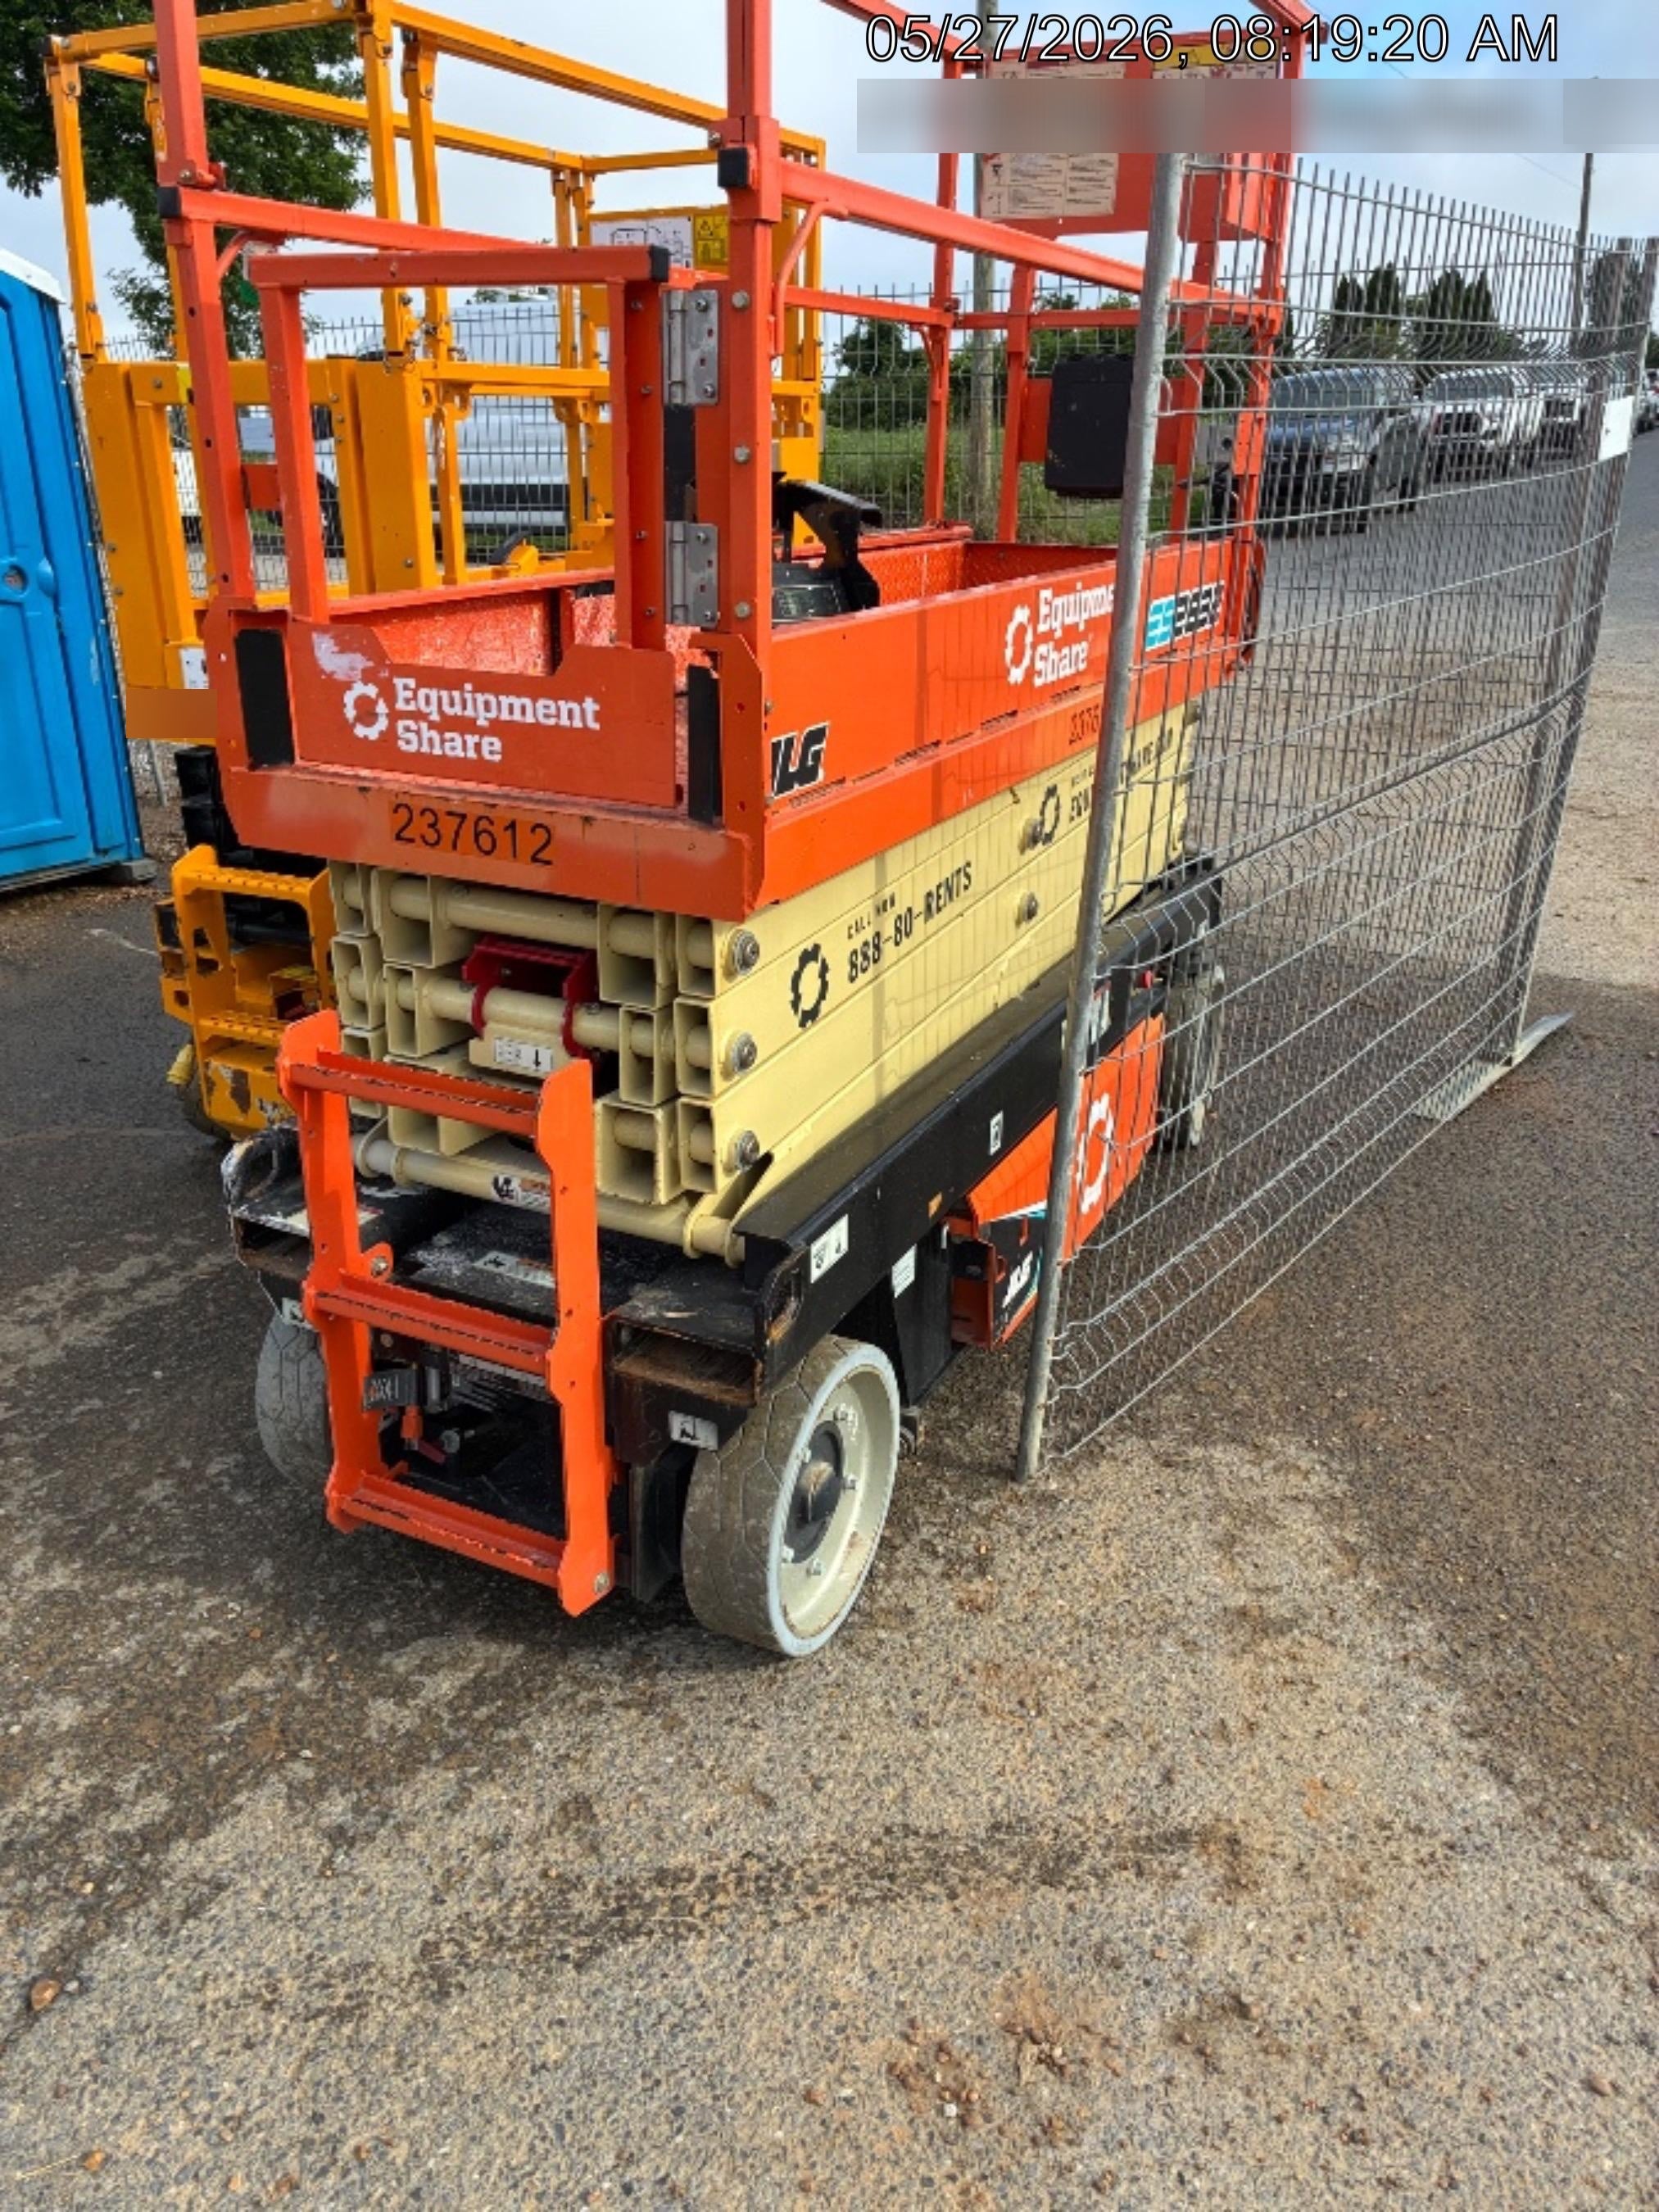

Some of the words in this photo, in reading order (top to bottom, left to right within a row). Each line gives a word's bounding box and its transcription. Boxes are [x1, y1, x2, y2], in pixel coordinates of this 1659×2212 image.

[1037, 582, 1114, 639] Equipme
[1034, 641, 1089, 687] Share
[393, 677, 601, 731] Equipment
[1068, 704, 1099, 746] 2376
[397, 719, 502, 763] Share
[392, 803, 553, 866] 237612
[848, 860, 972, 983] 888-80-RENTS
